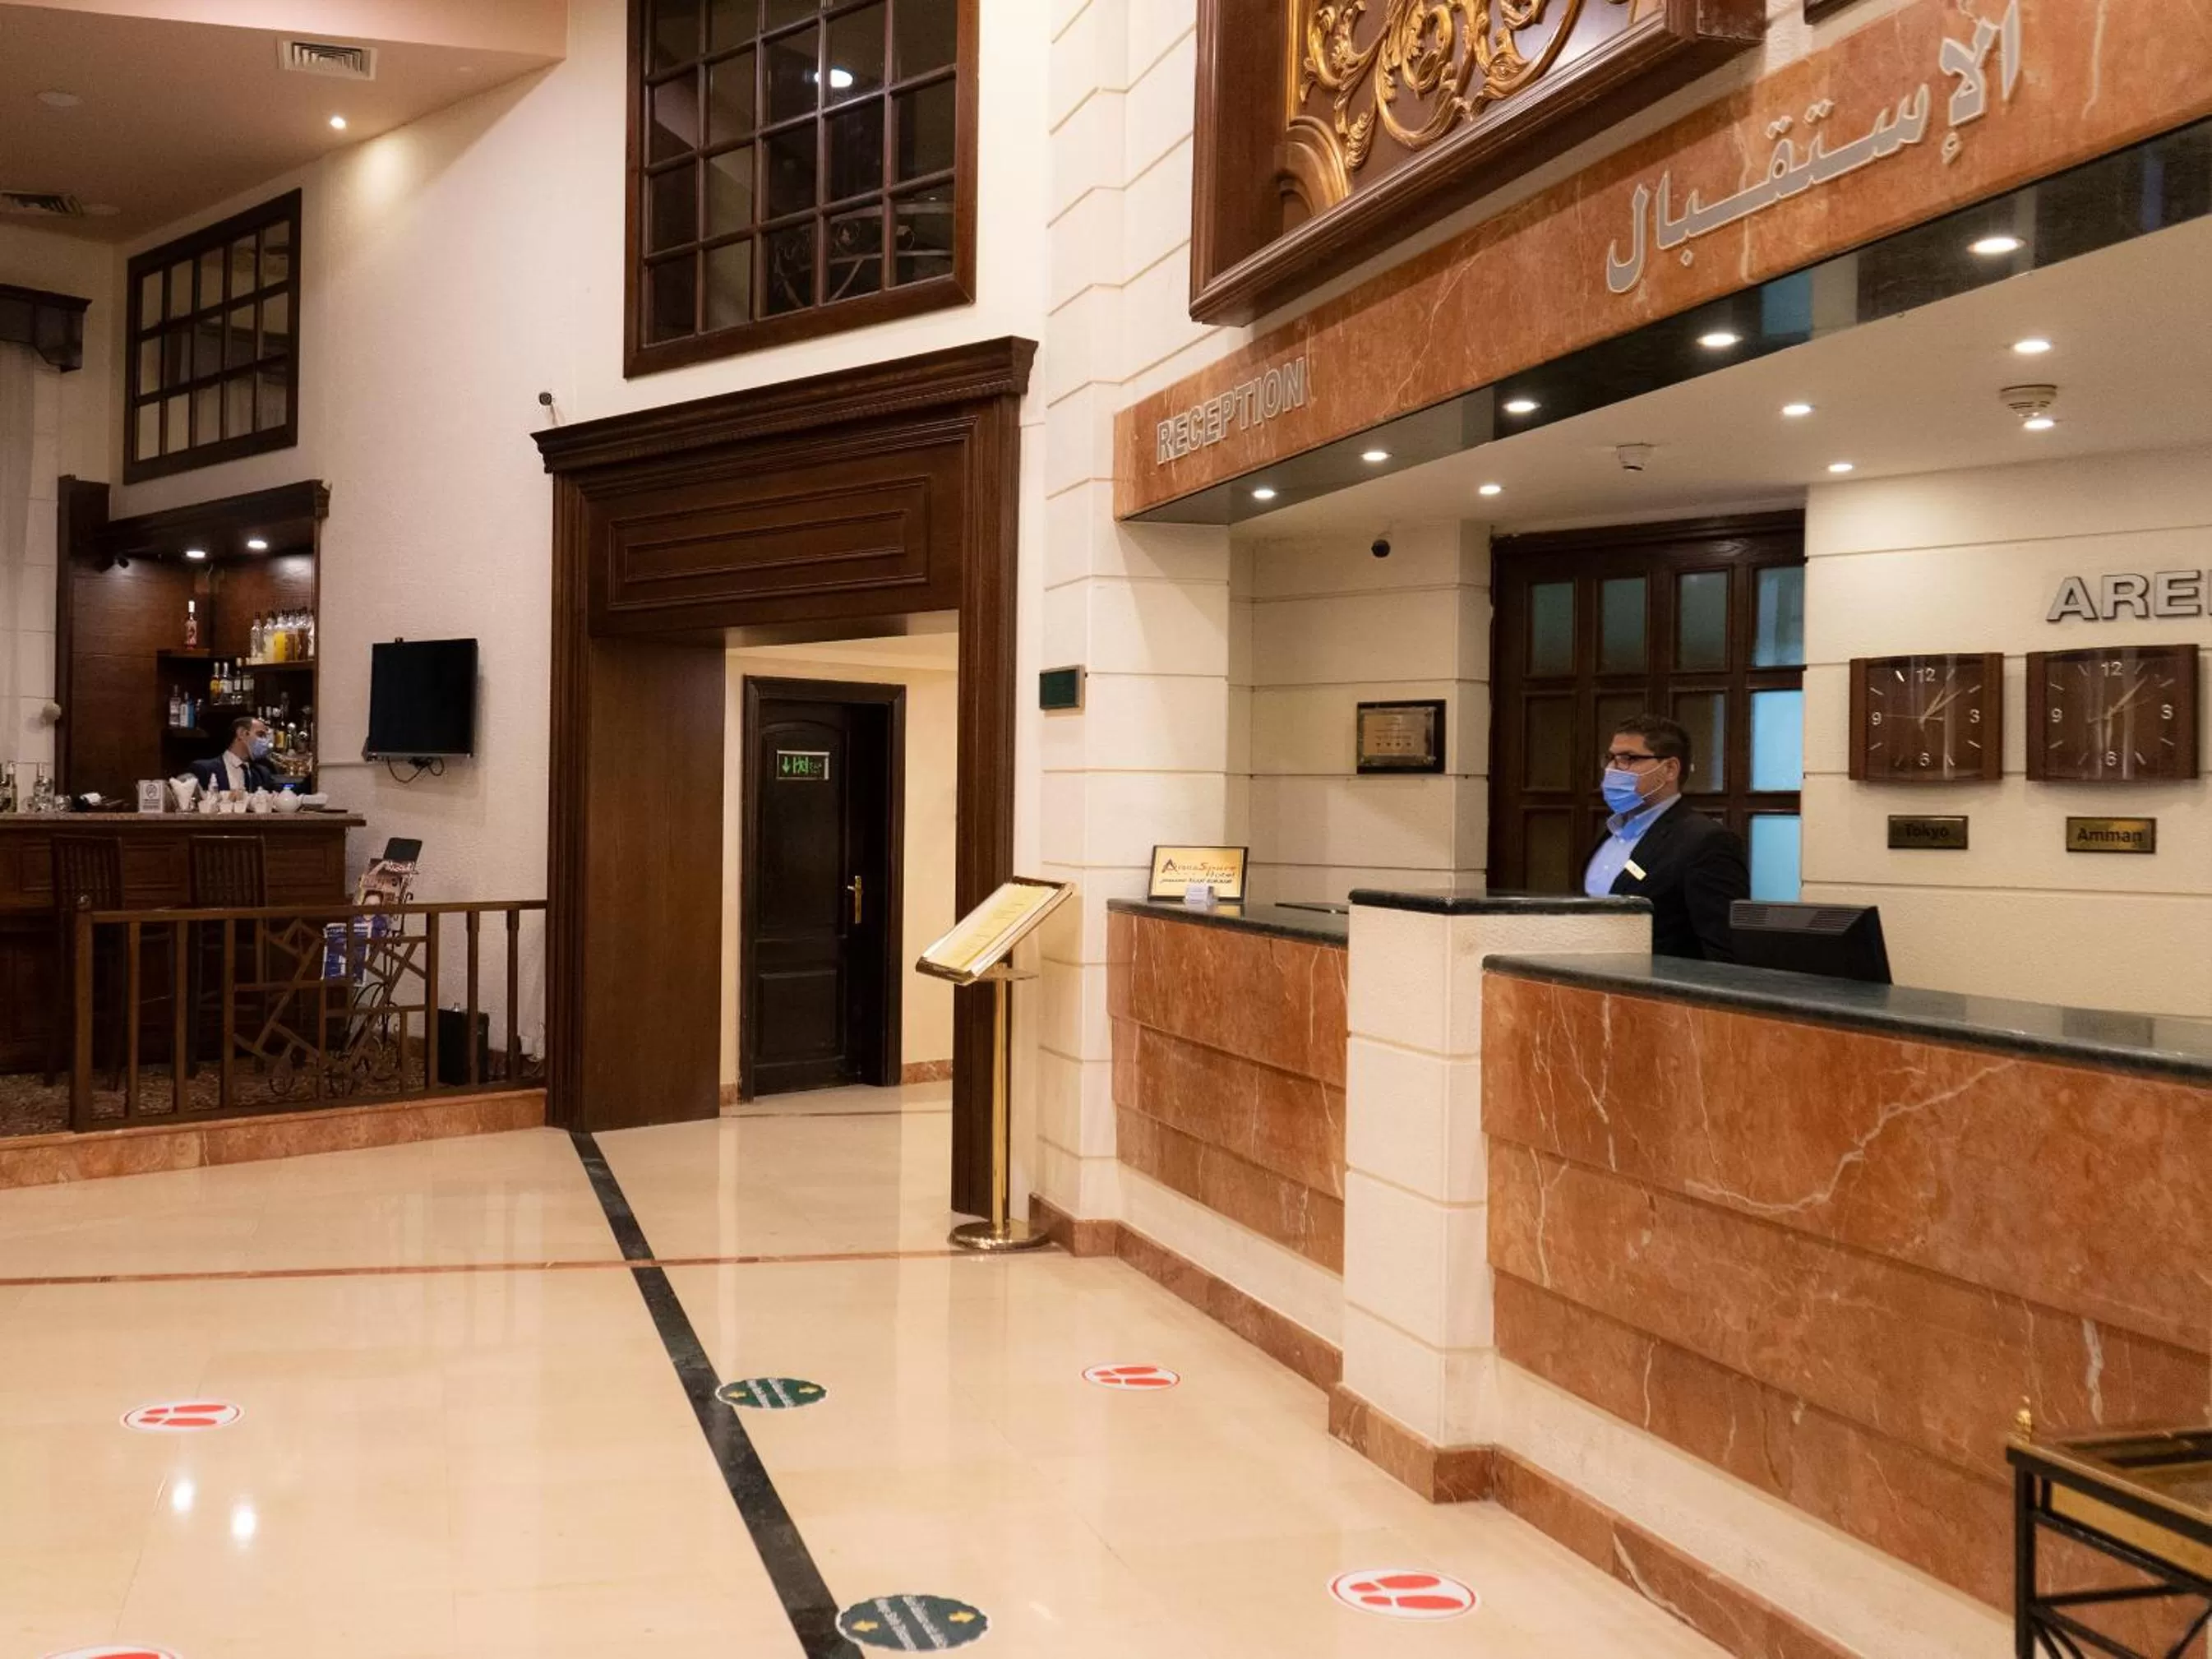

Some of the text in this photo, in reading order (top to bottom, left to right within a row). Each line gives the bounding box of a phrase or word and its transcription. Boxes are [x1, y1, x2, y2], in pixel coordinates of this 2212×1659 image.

[1607, 0, 2021, 293] الإستقبال
[1157, 356, 1306, 465] RECEPTION
[2046, 569, 2212, 622] ARE
[1916, 668, 1936, 683] 12
[2101, 661, 2123, 677] 12
[1871, 711, 1882, 725] 9
[1970, 709, 1980, 723] 3
[2051, 708, 2062, 723] 9
[2161, 704, 2173, 719] 3
[1919, 752, 1931, 766] 6
[2106, 751, 2117, 766] 6
[1904, 823, 1950, 839] Tokyo
[2077, 827, 2143, 842] Amman
